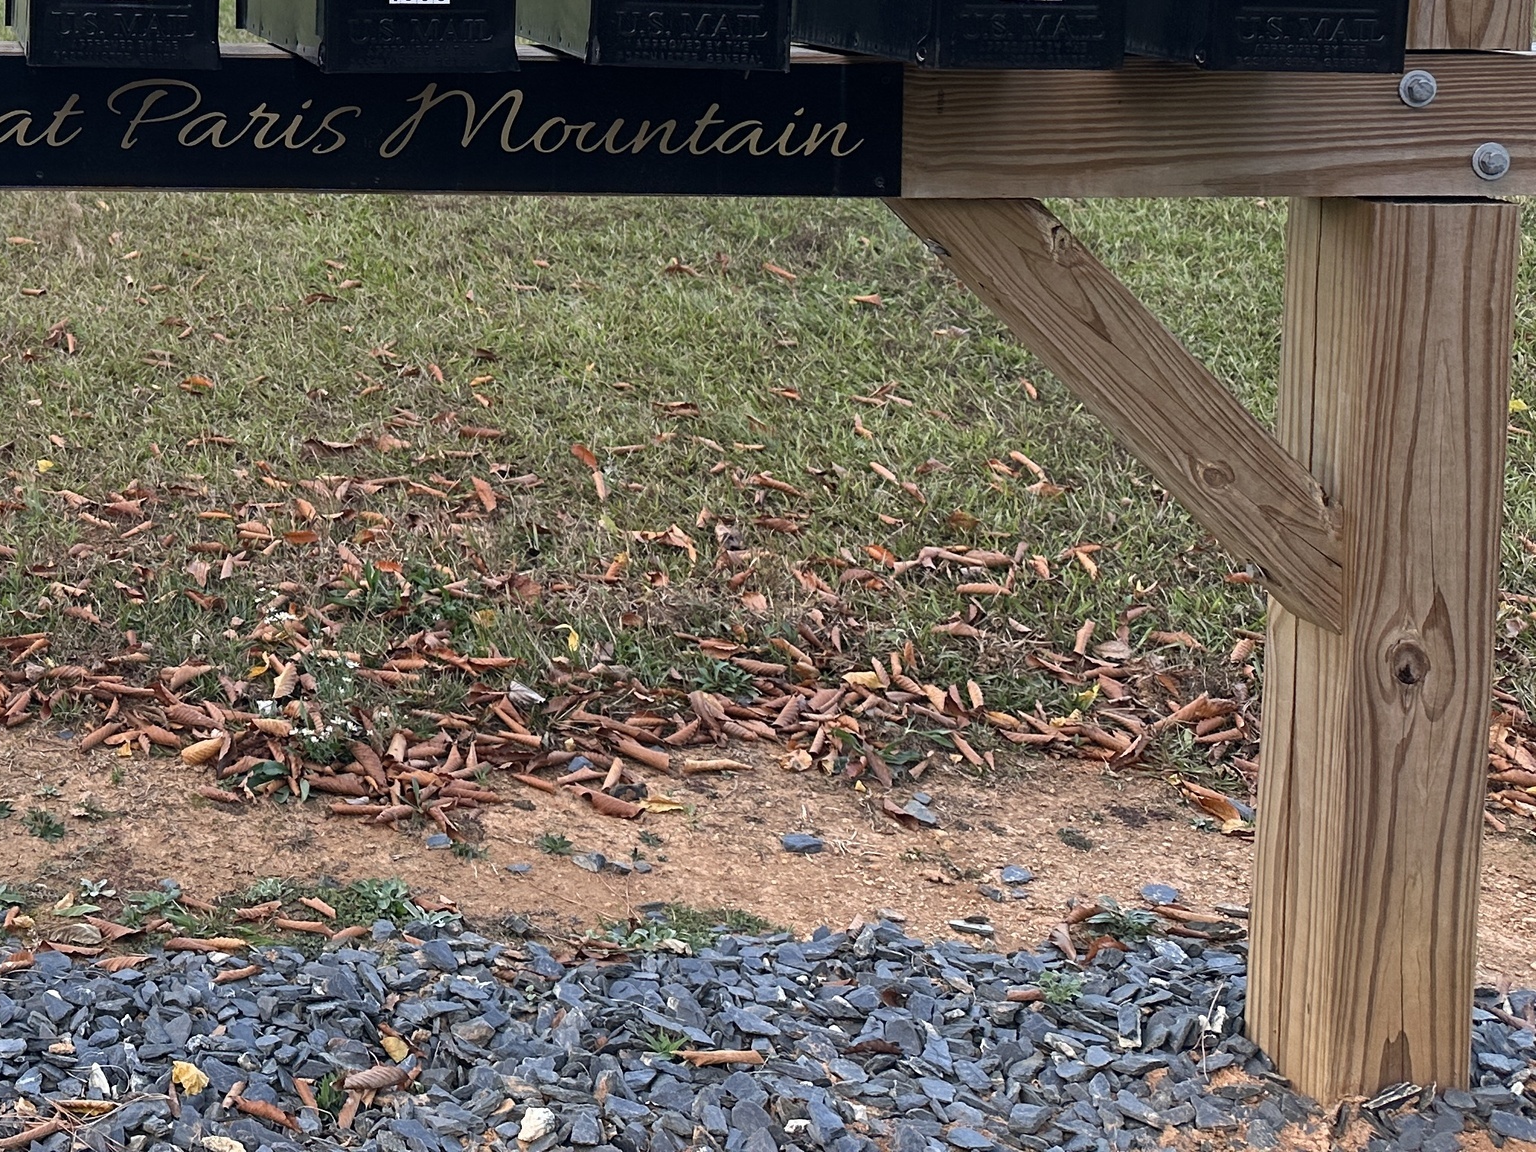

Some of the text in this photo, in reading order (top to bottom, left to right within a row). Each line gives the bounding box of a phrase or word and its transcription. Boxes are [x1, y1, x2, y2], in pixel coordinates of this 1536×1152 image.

[347, 18, 494, 44] U.S. MAIL
[615, 11, 768, 39] U.S. MAIL
[1235, 16, 1384, 43] U.S. MAIL
[107, 78, 362, 154] Paris
[378, 81, 864, 159] Mountain
